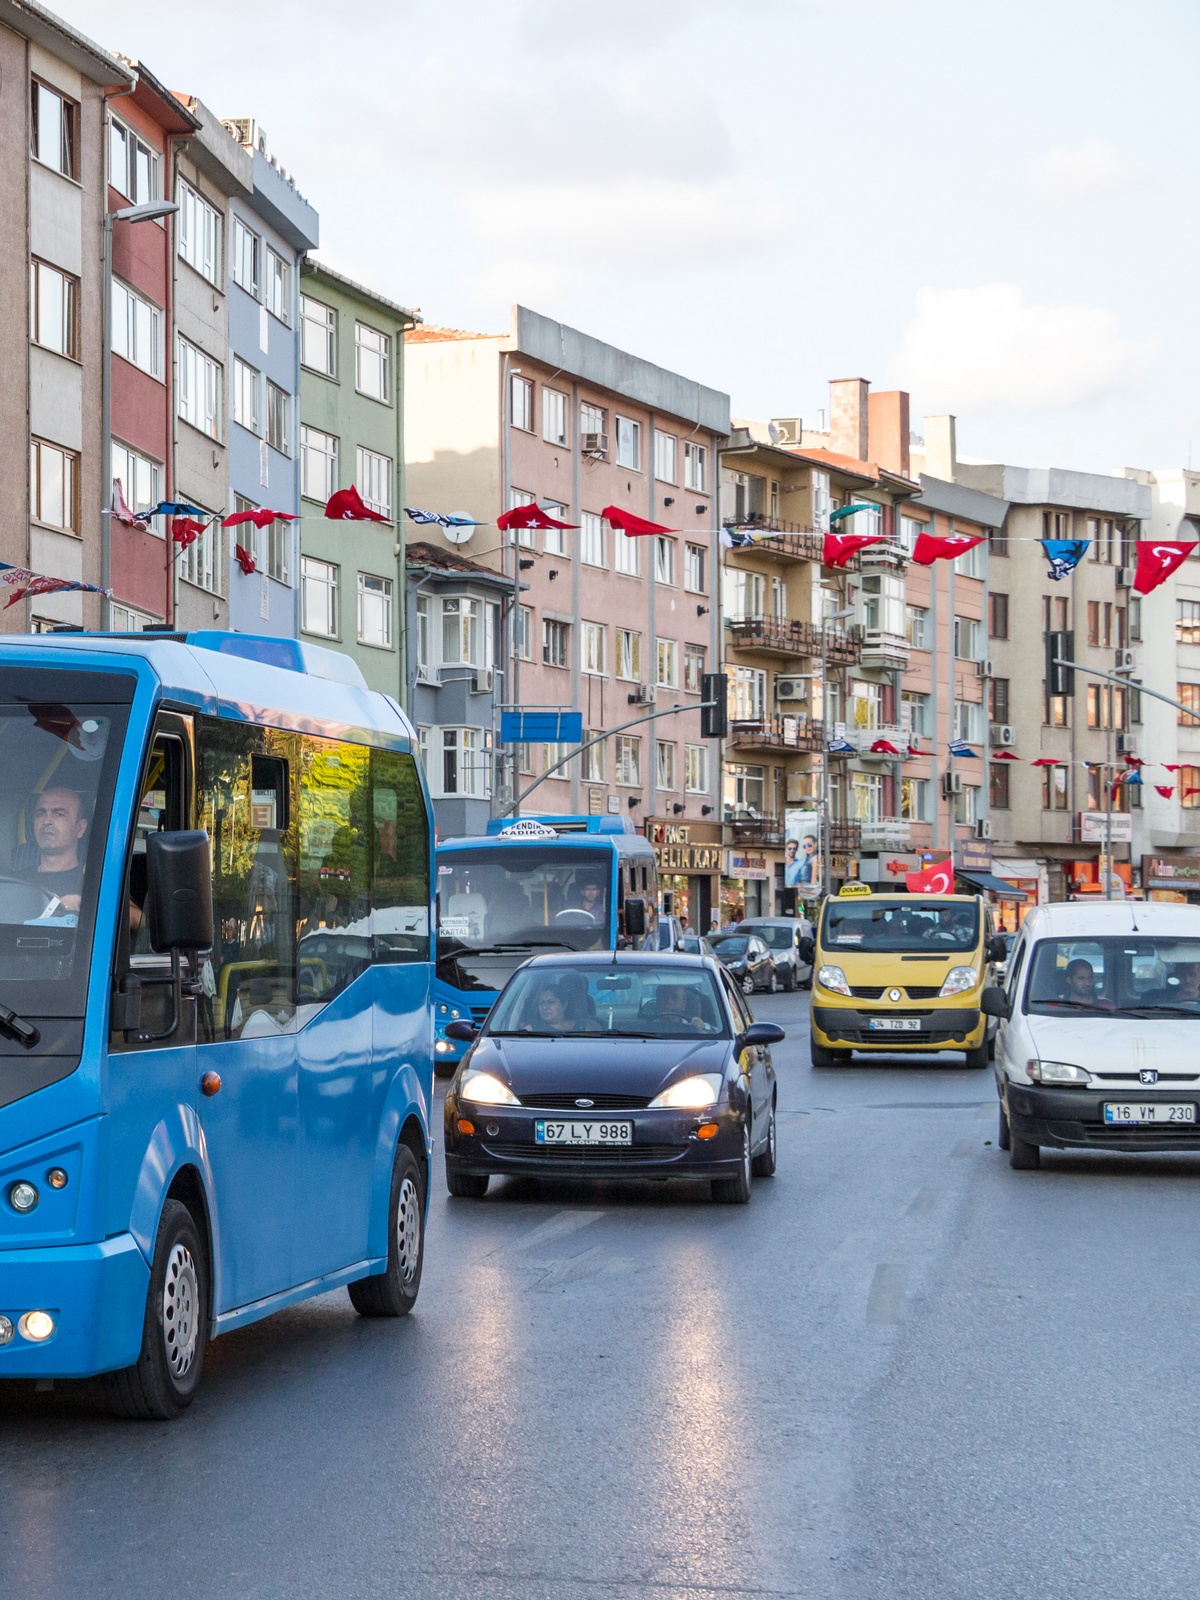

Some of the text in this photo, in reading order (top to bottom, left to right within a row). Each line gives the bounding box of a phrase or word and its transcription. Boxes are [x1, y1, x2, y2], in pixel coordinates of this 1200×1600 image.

[440, 928, 467, 936] KARTAL
[1116, 1106, 1193, 1121] 16 VM 230
[546, 1124, 629, 1139] 67 LY 988
